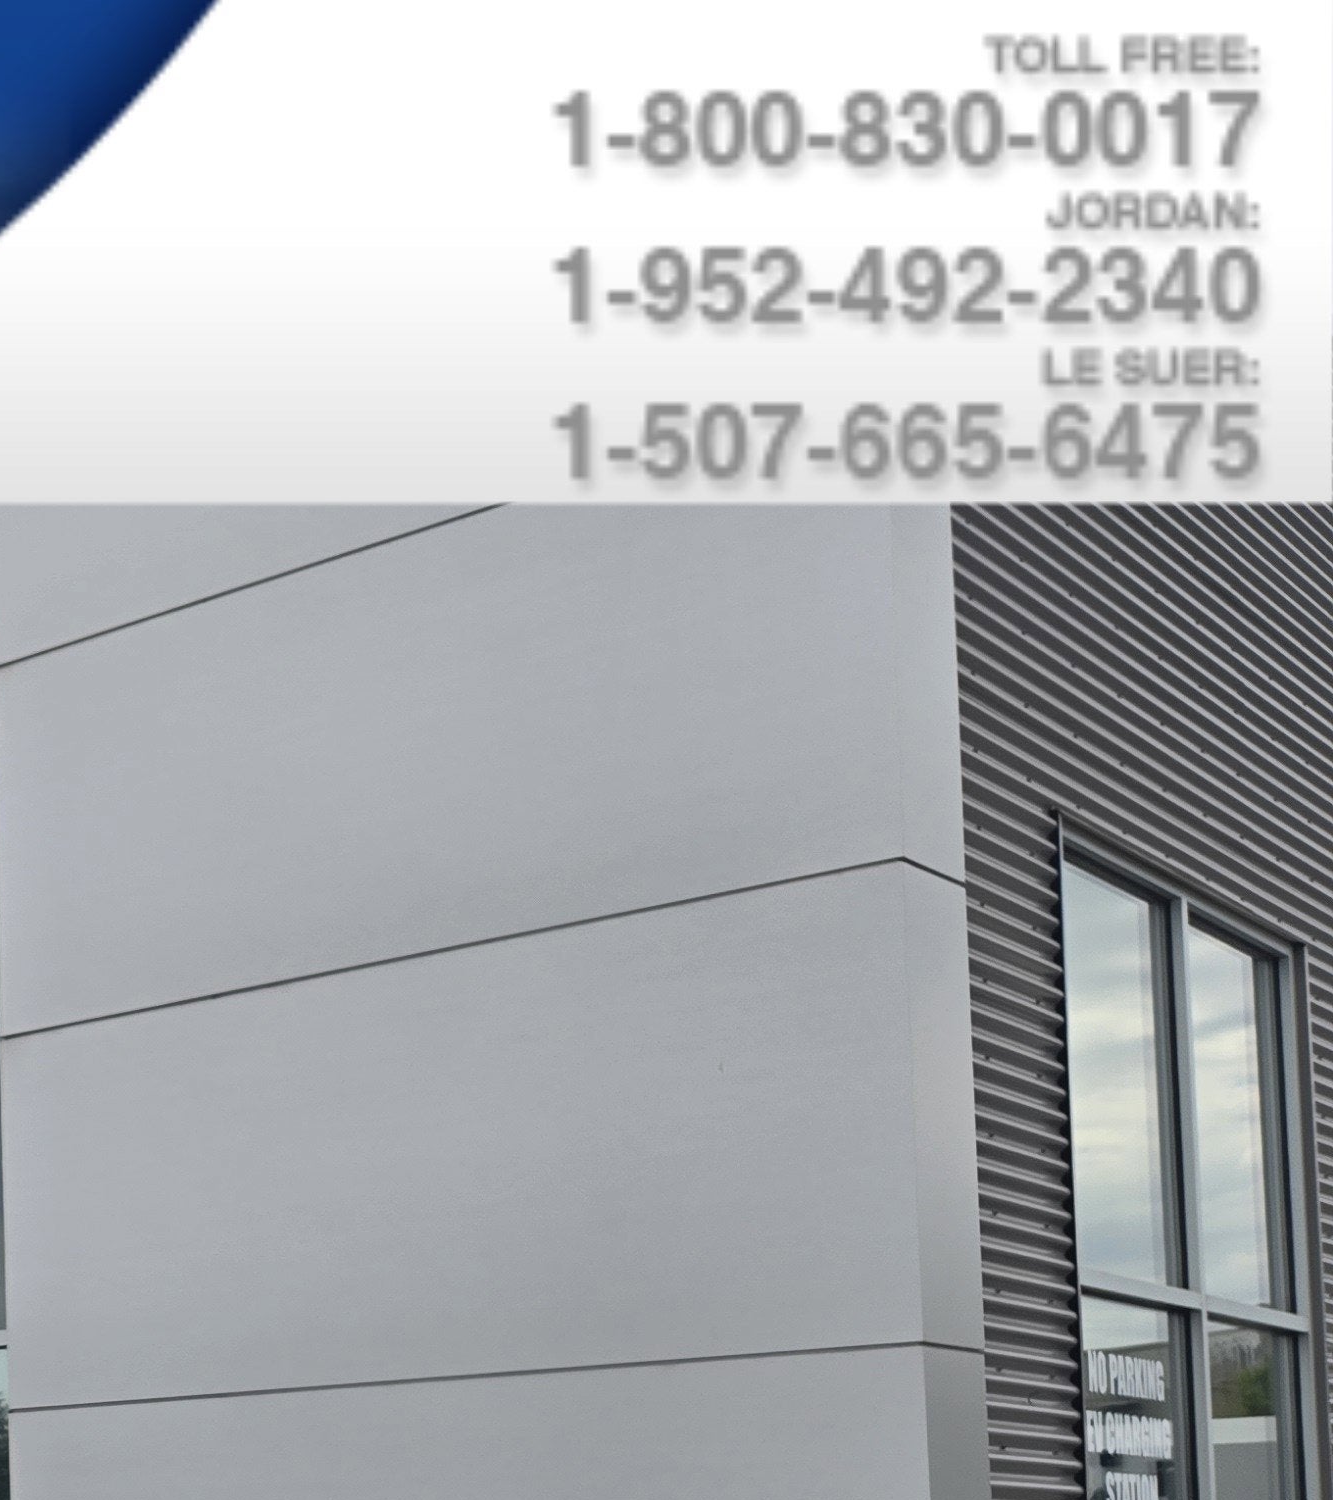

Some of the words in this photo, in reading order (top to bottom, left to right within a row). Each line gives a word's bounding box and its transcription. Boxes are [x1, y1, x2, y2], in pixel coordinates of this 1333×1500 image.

[1087, 1349, 1107, 1395] NO
[1108, 1353, 1165, 1402] PARKING
[1086, 1410, 1103, 1452] EV
[1104, 1411, 1172, 1459] CHARGING
